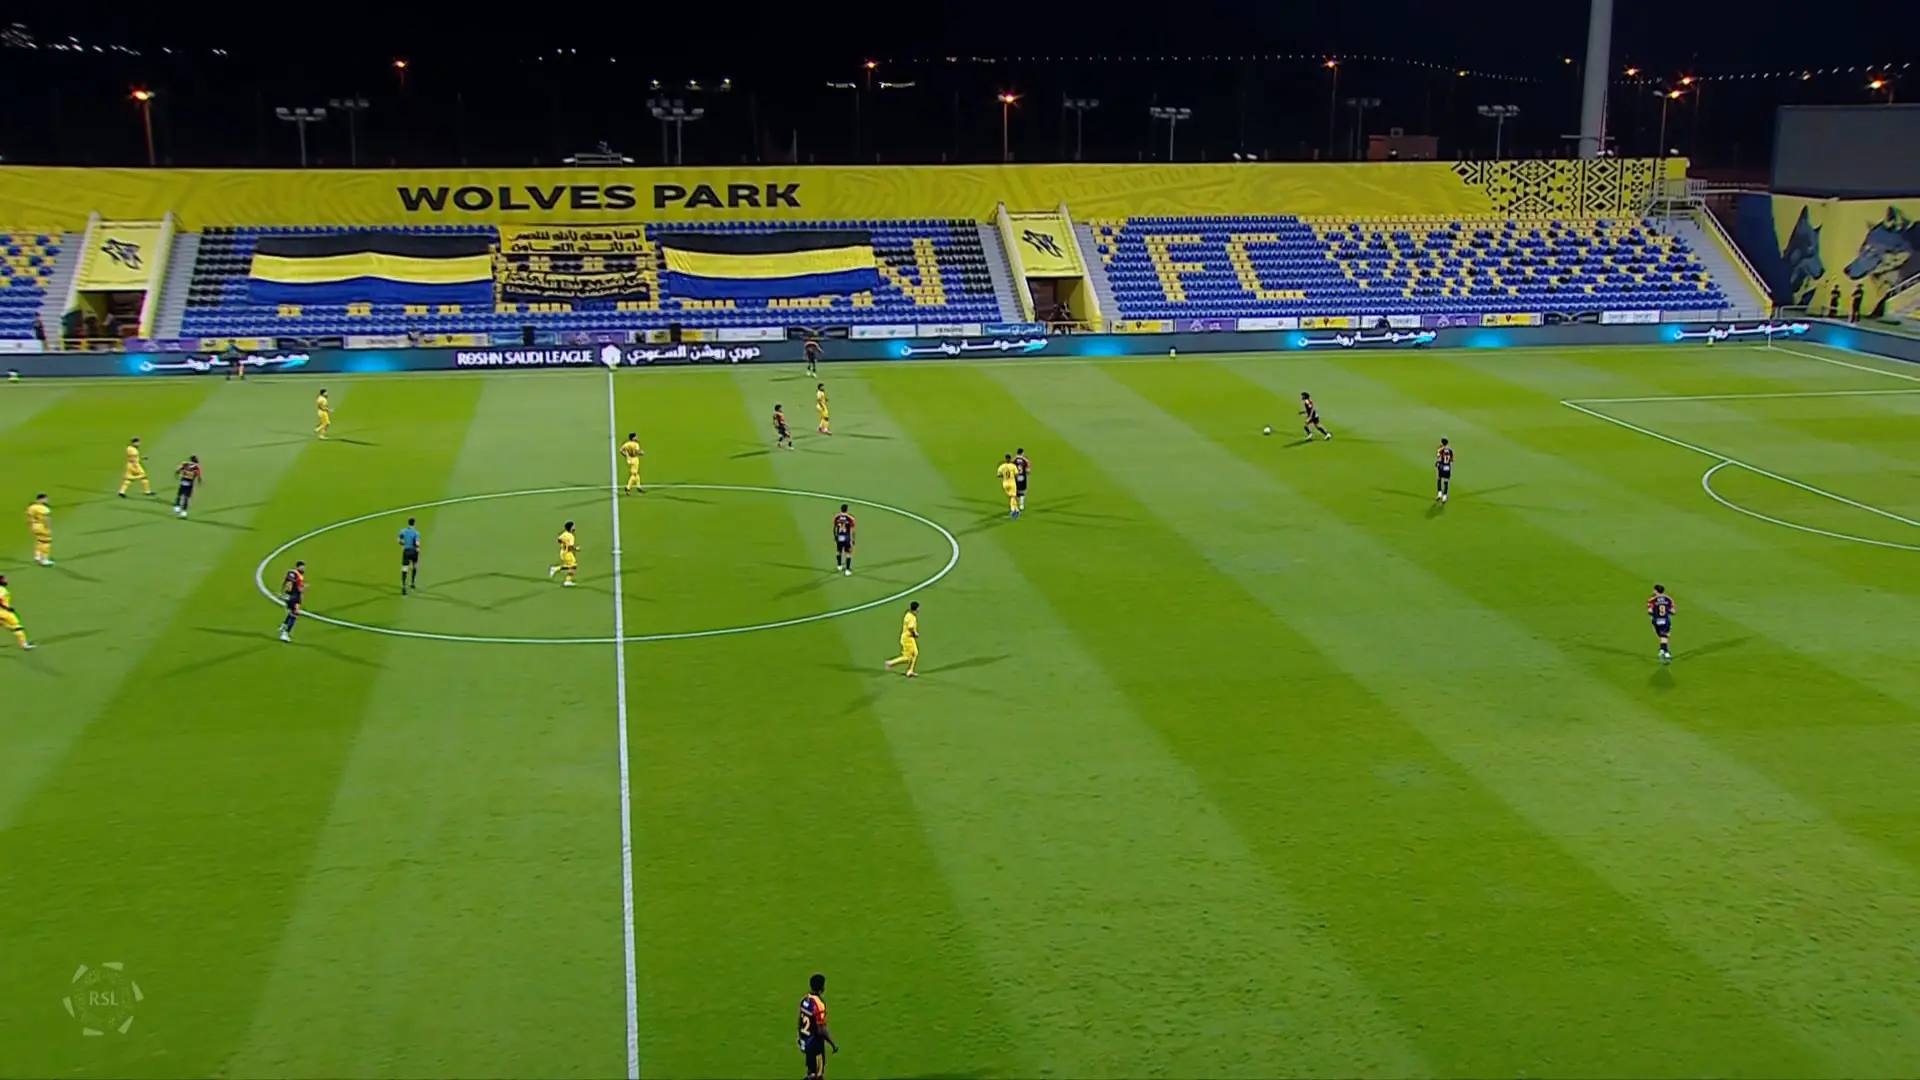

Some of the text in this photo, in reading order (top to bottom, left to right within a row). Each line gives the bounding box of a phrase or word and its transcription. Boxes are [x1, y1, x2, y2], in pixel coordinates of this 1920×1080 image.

[397, 183, 801, 212] WOLVES PARK
[457, 350, 593, 365] ROSHN SAUDI LEAGUE
[626, 344, 761, 365] دوري روشن السعودي
